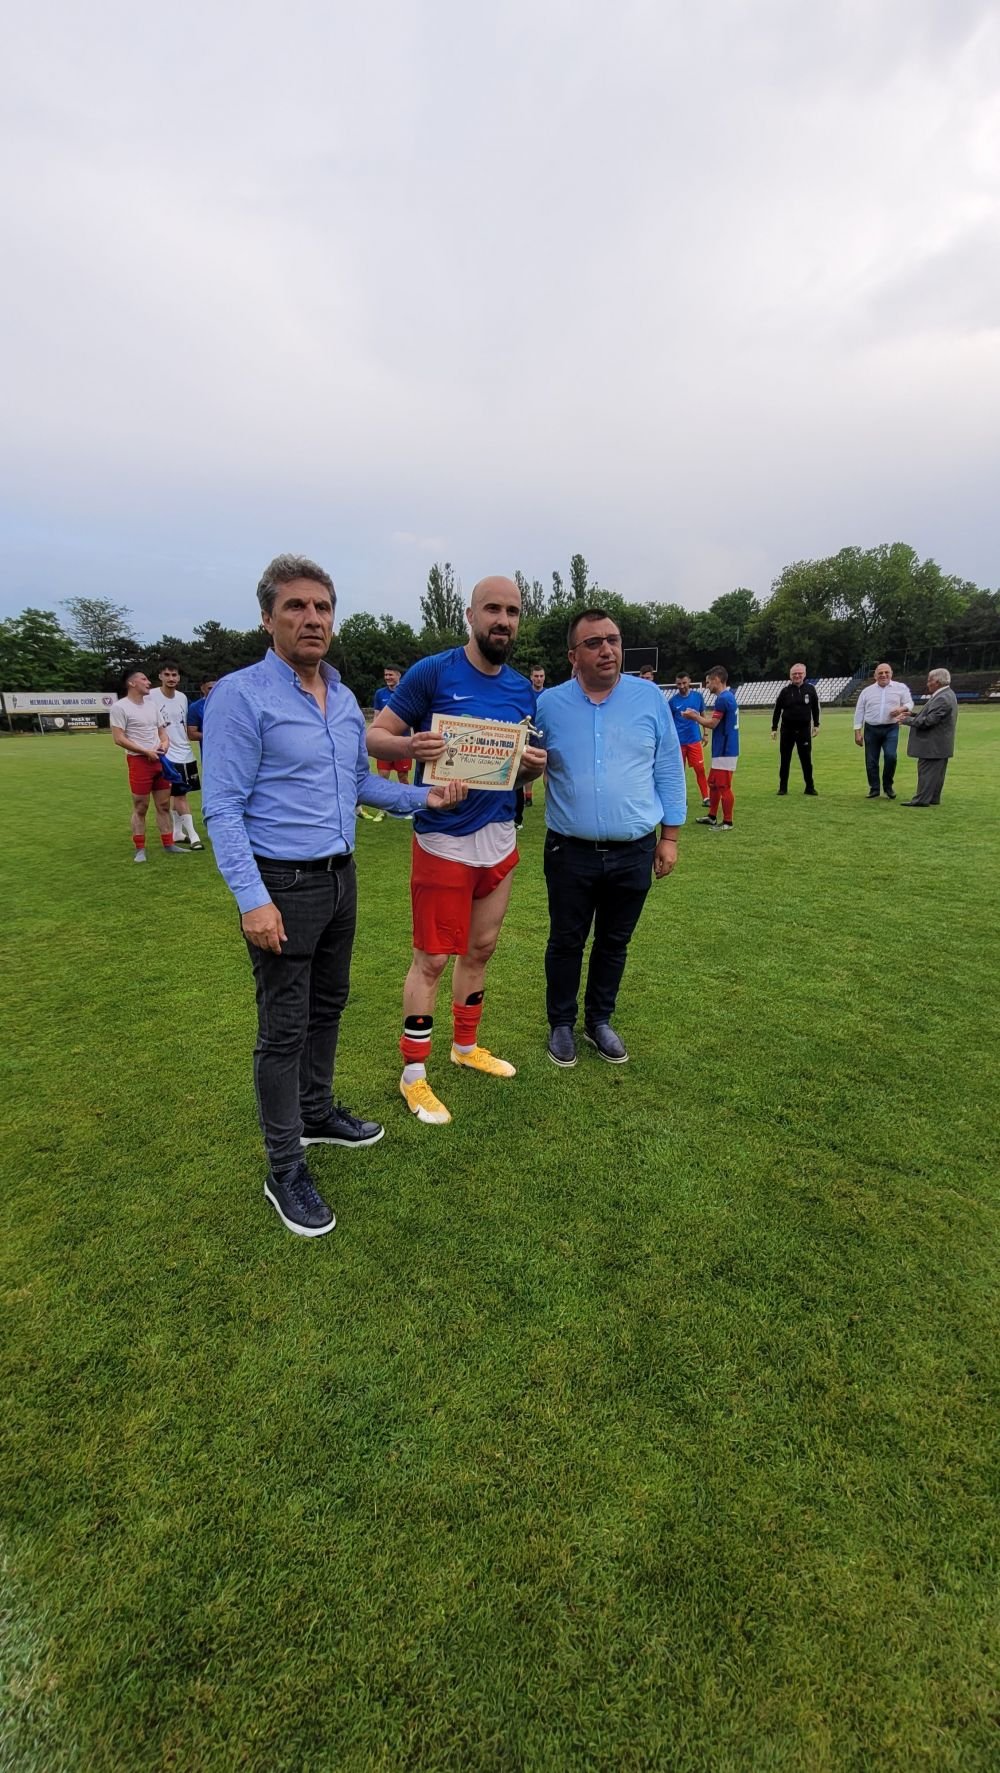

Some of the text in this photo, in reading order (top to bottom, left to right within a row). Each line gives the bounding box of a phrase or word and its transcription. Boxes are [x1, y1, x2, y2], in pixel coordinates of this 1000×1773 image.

[476, 737, 486, 745] LIGA
[499, 740, 515, 749] TULCEA
[460, 744, 510, 758] DIPLOMA
